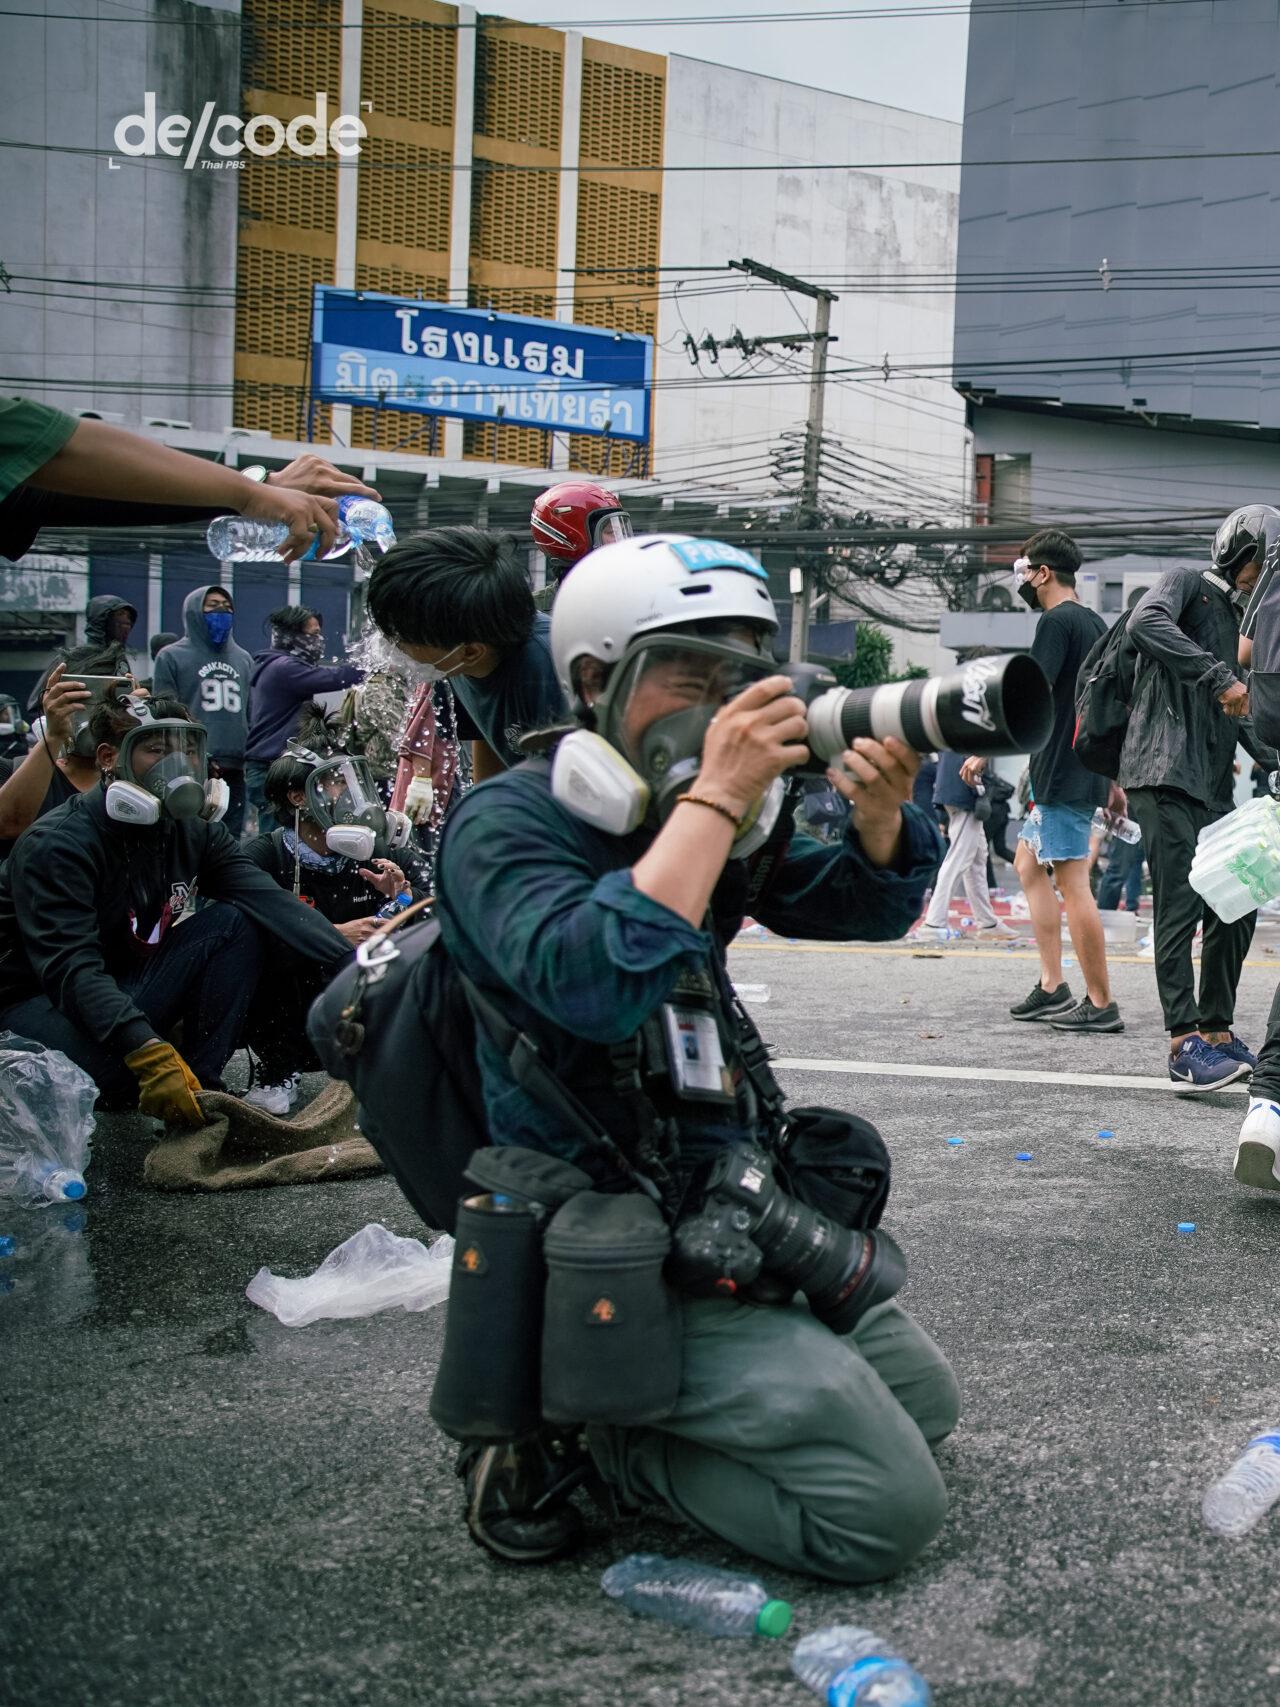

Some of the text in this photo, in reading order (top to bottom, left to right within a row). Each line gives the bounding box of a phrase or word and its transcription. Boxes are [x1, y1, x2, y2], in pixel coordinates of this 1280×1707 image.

[395, 308, 584, 379] โรงแรม
[201, 679, 242, 713] 96
